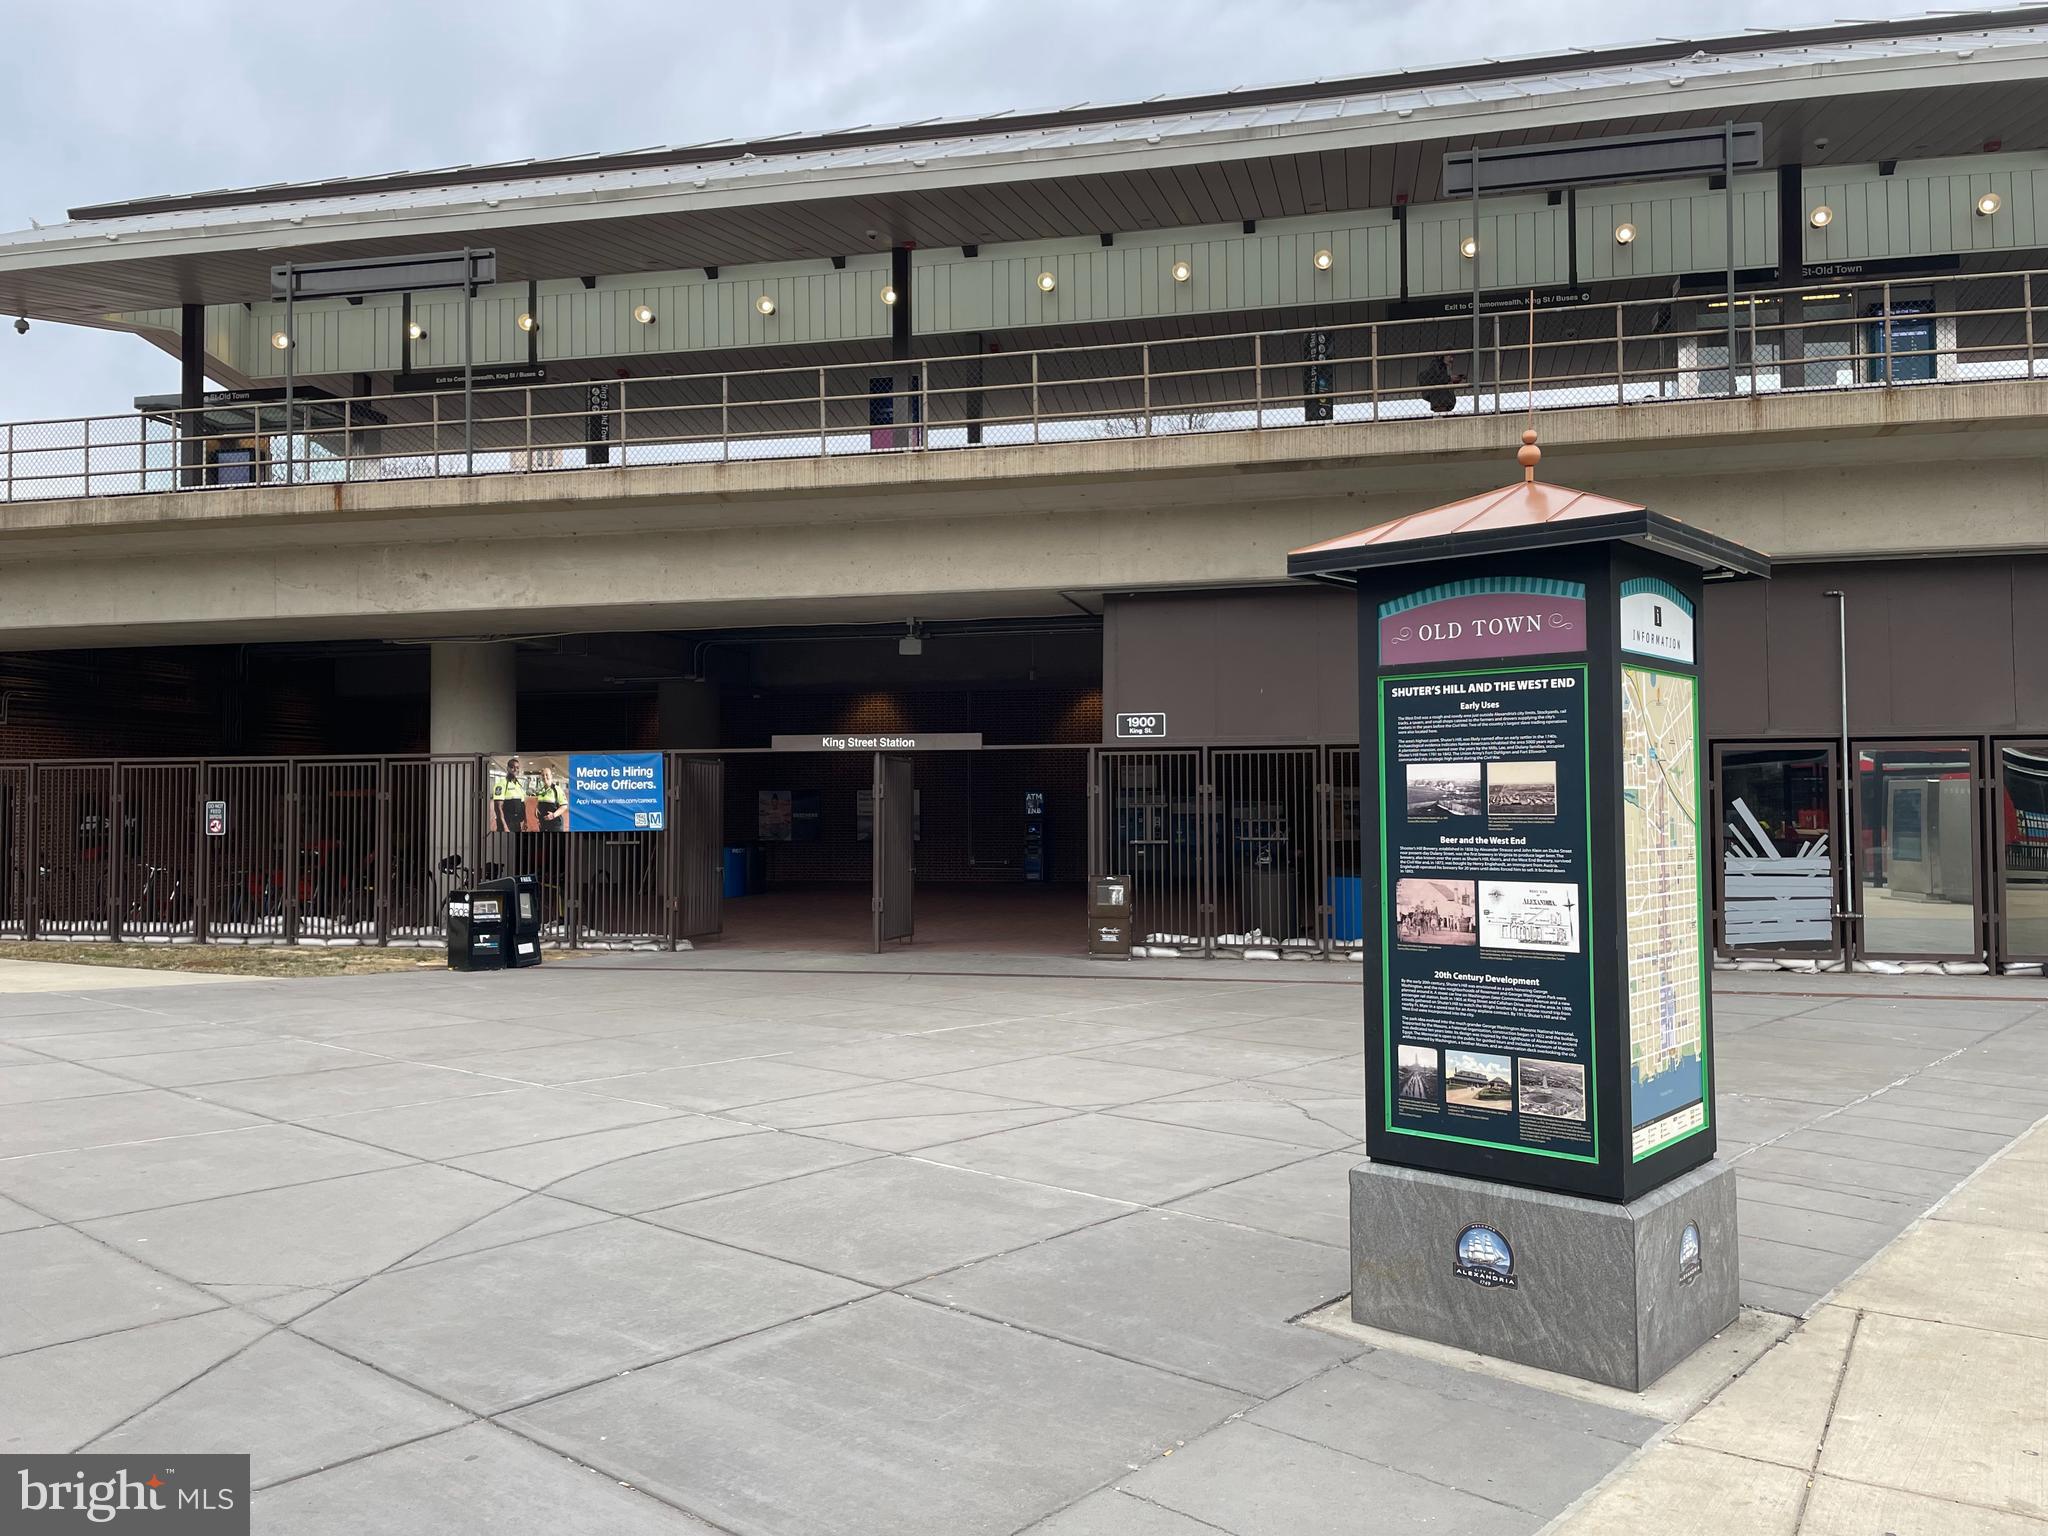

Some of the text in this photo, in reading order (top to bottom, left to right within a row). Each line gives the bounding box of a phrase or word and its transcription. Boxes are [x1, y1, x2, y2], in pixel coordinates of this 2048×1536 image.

[1835, 264, 1862, 274] Town
[1468, 299, 1523, 308] Cmmonwealth,
[1556, 294, 1578, 302] Buses
[1418, 615, 1542, 641] OLD TOWN
[1633, 629, 1681, 650] INFORMATION
[1391, 677, 1576, 698] SHUTER'S HILL AND THE WEST END
[1460, 701, 1500, 711] Early Uses
[1127, 717, 1155, 727] 1900
[822, 737, 915, 749] King Street Station
[576, 766, 653, 778] Metro is Hiring
[576, 779, 656, 791] Police Officers.
[1440, 836, 1526, 845] Beer and the West End
[1434, 971, 1540, 986] 20th Century Development
[1456, 1269, 1515, 1285] ALEXANDRIA
